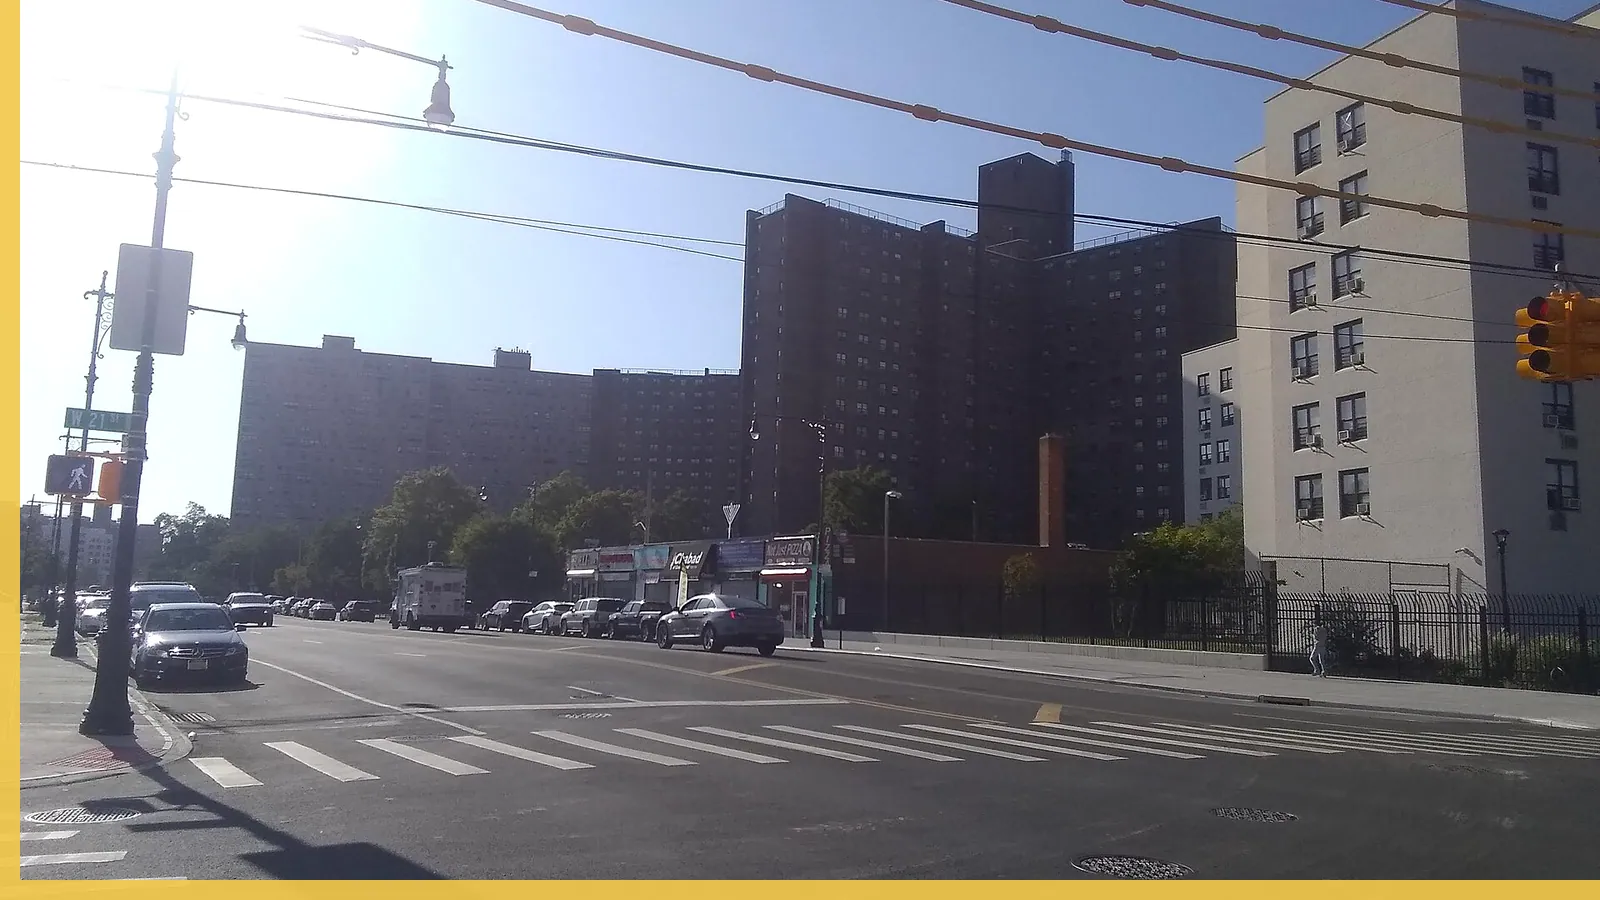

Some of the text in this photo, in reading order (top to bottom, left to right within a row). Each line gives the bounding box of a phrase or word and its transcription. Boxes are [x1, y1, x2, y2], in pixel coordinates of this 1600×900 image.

[71, 410, 83, 427] W
[89, 412, 106, 429] 21
[787, 543, 803, 556] PIZZA
